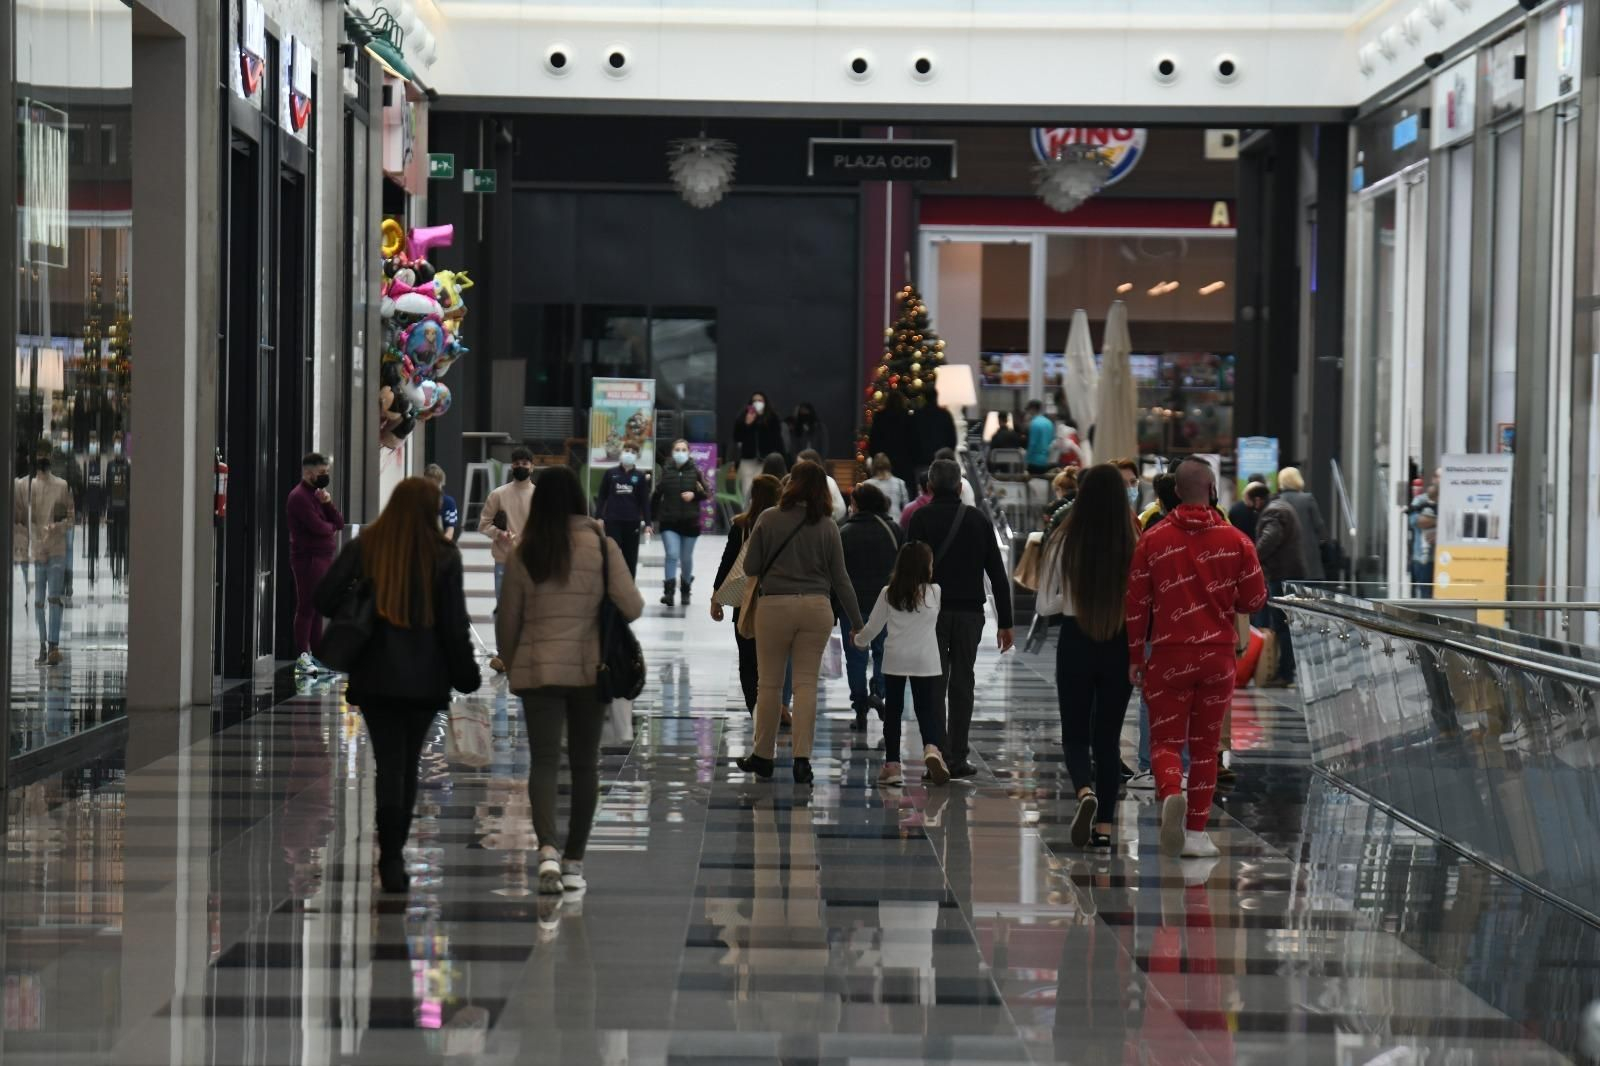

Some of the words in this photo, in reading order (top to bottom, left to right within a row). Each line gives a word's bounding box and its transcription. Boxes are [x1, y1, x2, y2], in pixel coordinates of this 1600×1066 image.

[833, 154, 887, 168] PLAZA
[891, 156, 931, 168] OCIO
[1196, 547, 1240, 563] Endless
